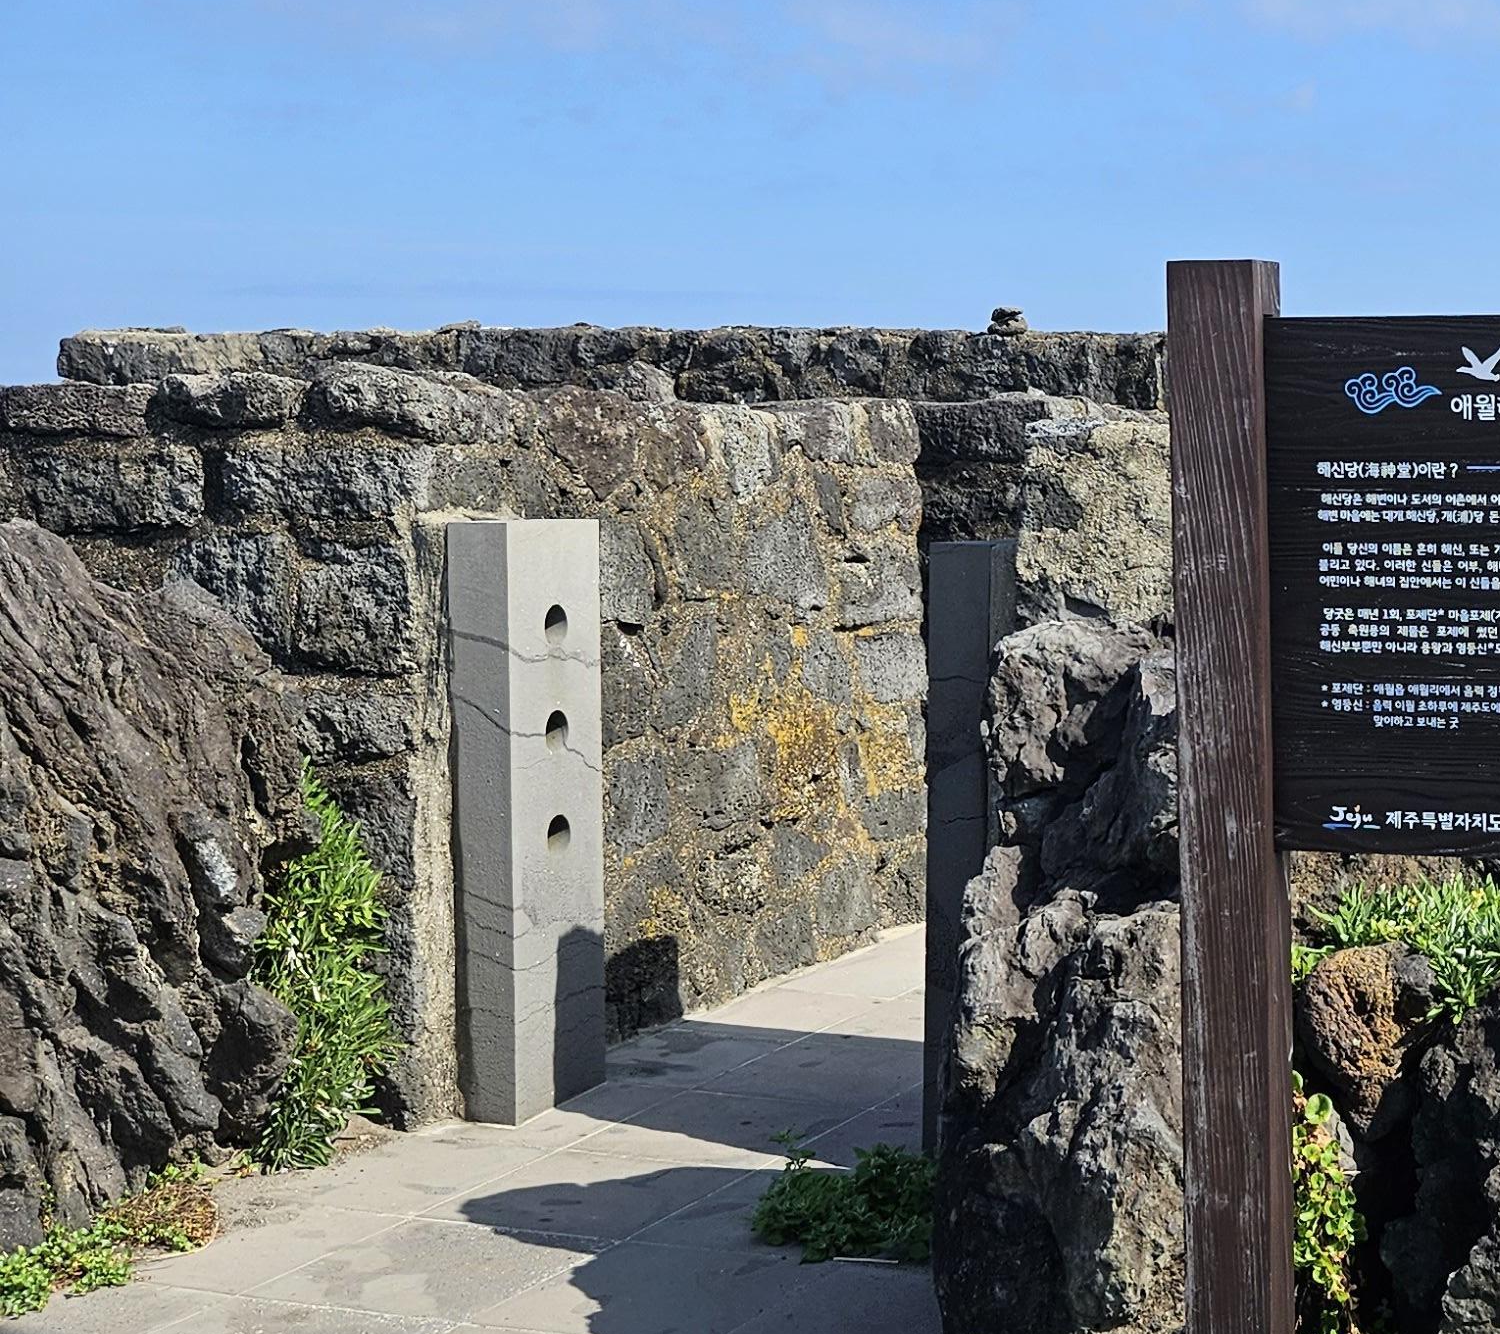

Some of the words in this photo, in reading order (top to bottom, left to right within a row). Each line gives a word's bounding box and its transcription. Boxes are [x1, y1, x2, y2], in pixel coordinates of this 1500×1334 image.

[1321, 493, 1363, 505] 해신당은
[1366, 494, 1408, 505] 해변이나
[1411, 494, 1441, 505] 도서의
[1318, 510, 1338, 521] 해변
[1340, 510, 1380, 522] 마을에는
[1381, 511, 1404, 522] 대개
[1406, 509, 1439, 523] 해신당,
[1323, 542, 1342, 555] 이들
[1347, 543, 1377, 555] 당신의
[1382, 543, 1412, 555] 이름은
[1441, 544, 1465, 556] 해신,
[1470, 544, 1489, 556] 또는
[1319, 559, 1350, 571] 불리고
[1355, 559, 1379, 571] 있다.
[1384, 560, 1416, 572] 이러한
[1422, 560, 1453, 572] 신들은
[1458, 561, 1482, 572] 어부,
[1319, 576, 1361, 587] 어민이나
[1364, 576, 1395, 587] 해녀의
[1399, 577, 1452, 589] 집안에서는
[1455, 577, 1466, 588] 이
[1470, 577, 1500, 589] 신들을
[1324, 608, 1354, 620] 당굿은
[1358, 609, 1378, 620] 매년
[1383, 609, 1402, 621] 1회,
[1320, 624, 1340, 636] 공동
[1437, 626, 1469, 637] 포제에
[1385, 642, 1417, 652] 아니라
[1421, 642, 1453, 654] 용왕과
[1332, 683, 1363, 695] 포제단
[1408, 684, 1460, 696] 애월리에서
[1464, 685, 1483, 697] 음력
[1332, 699, 1362, 711] 영등신
[1373, 699, 1392, 711] 음력
[1395, 700, 1414, 712] 이월
[1418, 701, 1458, 712] 초하루에
[1461, 702, 1500, 713] 제주도에
[1374, 716, 1413, 727] 맞이하고
[1417, 717, 1446, 728] 보내는
[1449, 717, 1458, 729] 굿
[1328, 806, 1374, 829] Jeju
